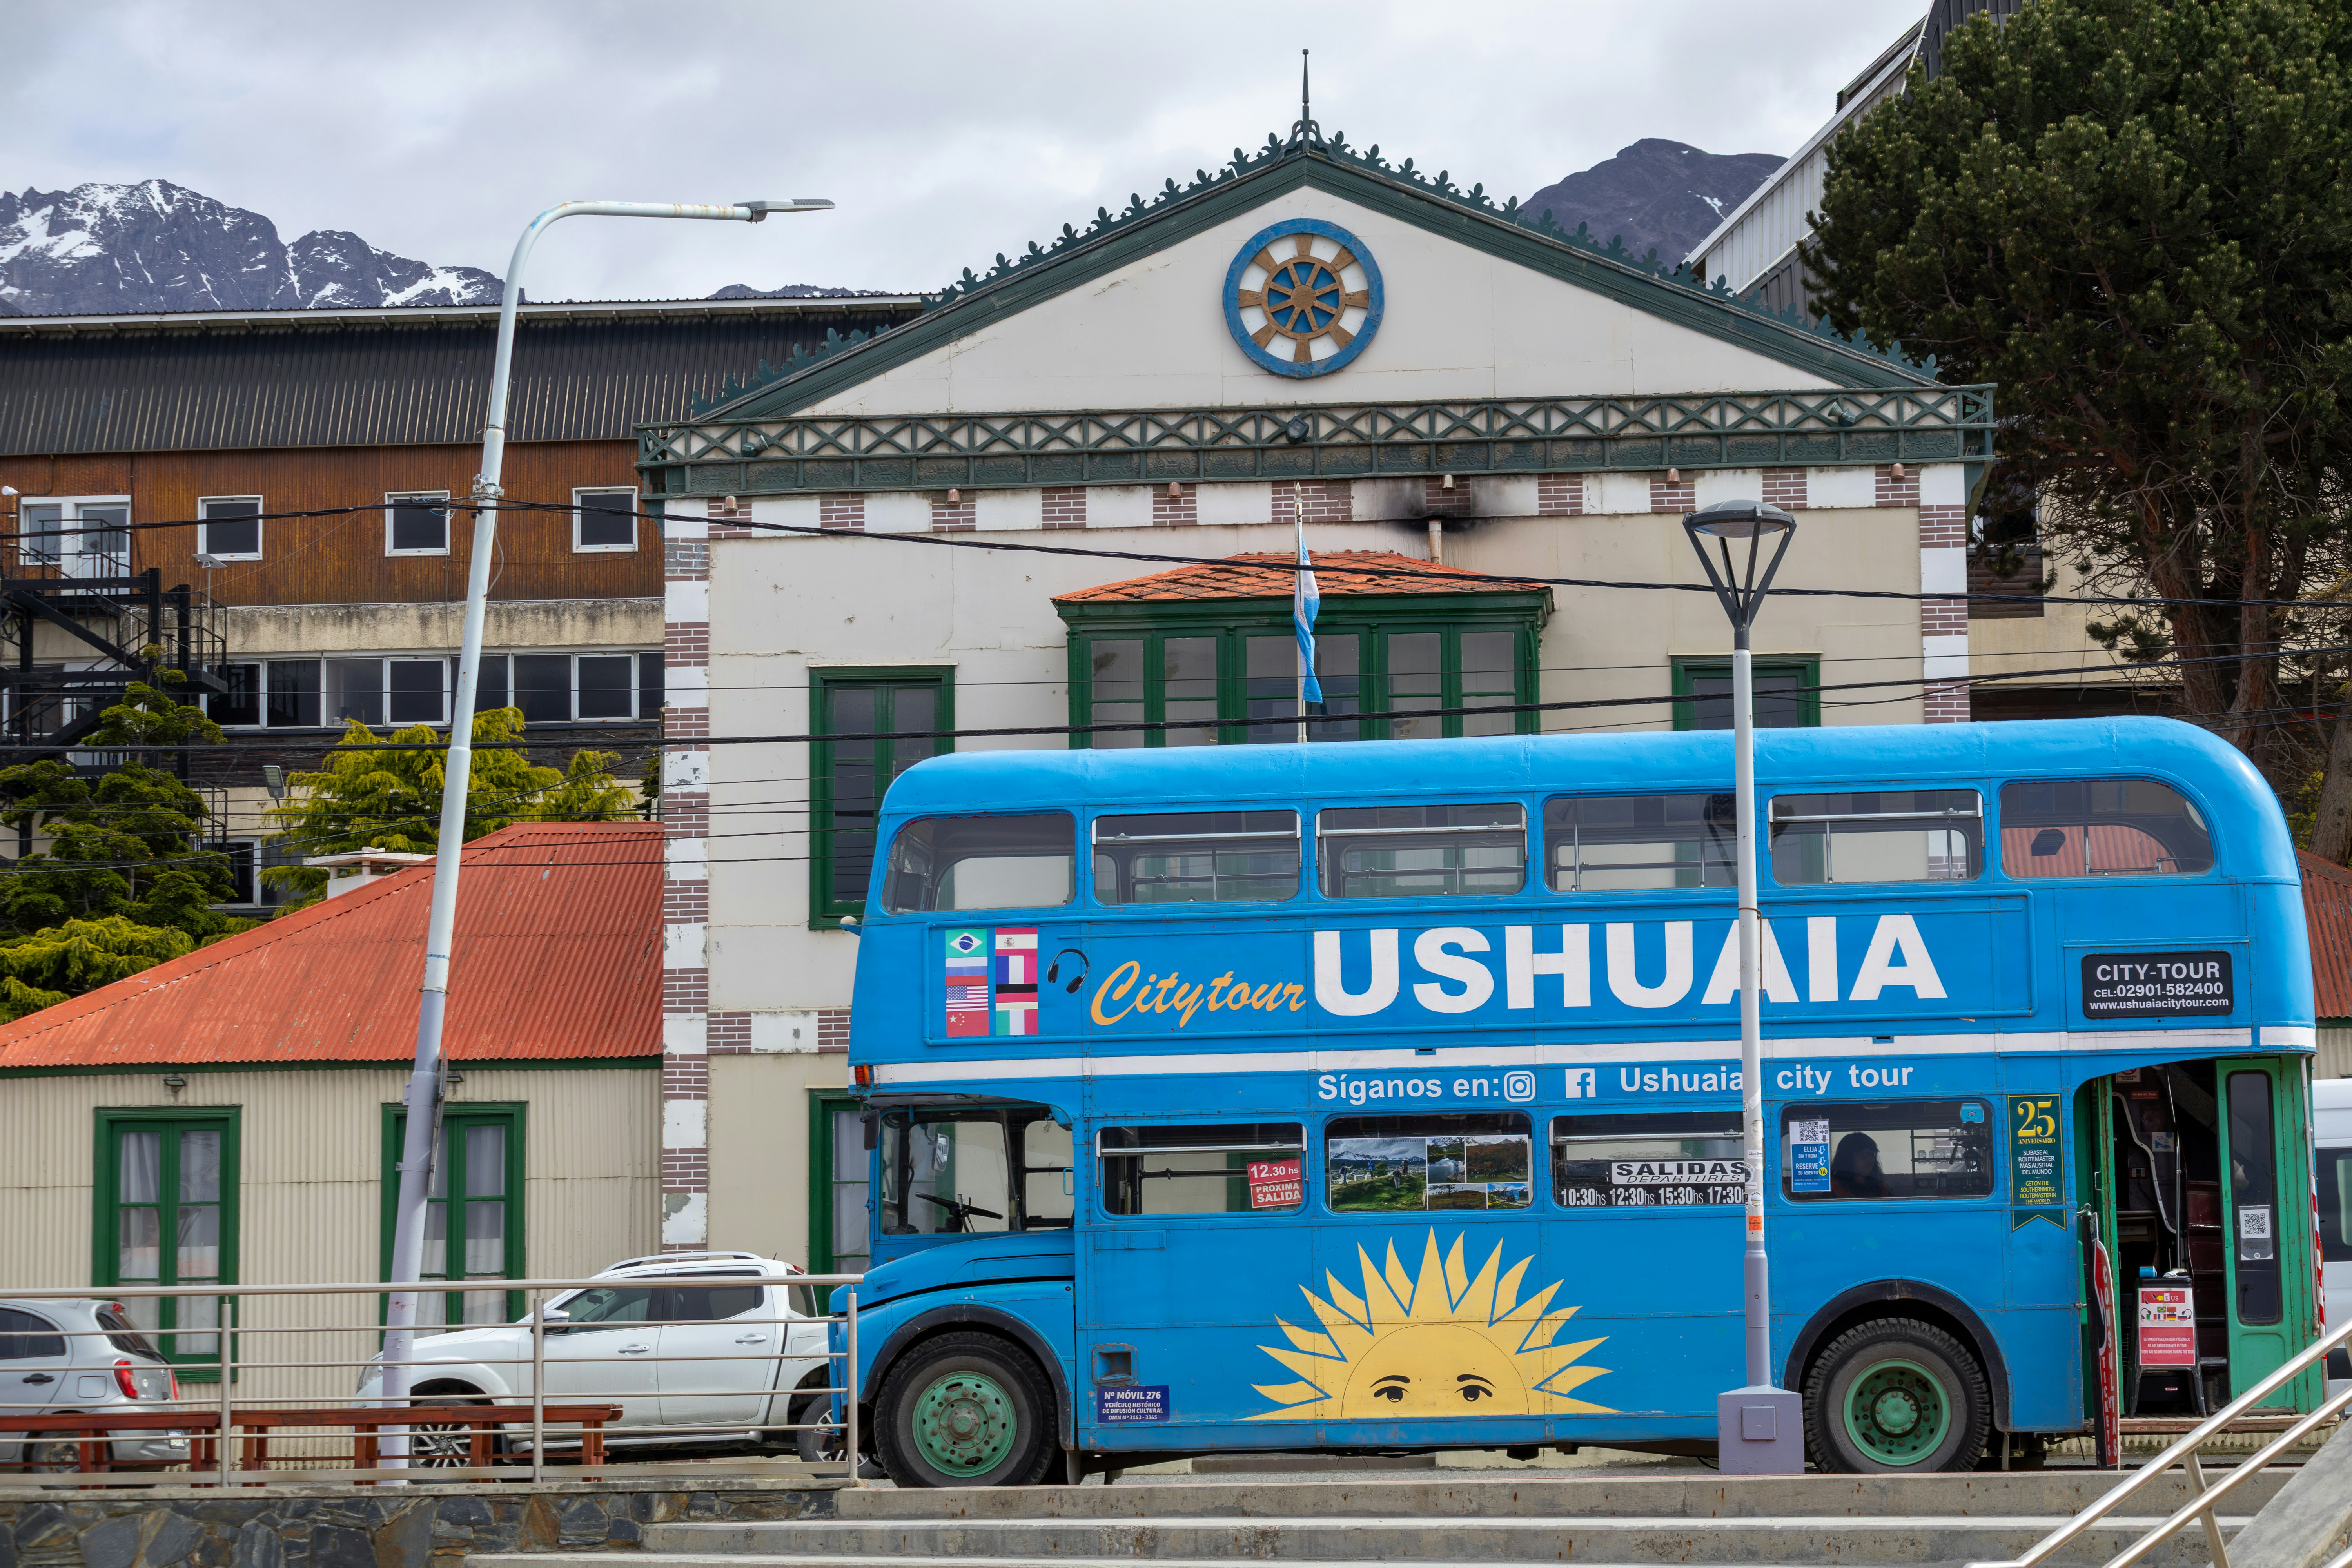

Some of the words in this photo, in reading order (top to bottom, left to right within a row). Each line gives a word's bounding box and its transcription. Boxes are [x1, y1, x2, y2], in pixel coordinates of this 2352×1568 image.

[1314, 915, 1948, 1017] USHUAIA
[2096, 962, 2220, 981] CITY-TOUR
[2089, 998, 2229, 1009] www.ushuaiacitytour.com
[1620, 1066, 1743, 1092] Ushuaia
[1777, 1064, 1832, 1095] city
[1849, 1064, 1914, 1087] tour
[1318, 1074, 1443, 1105] Síganos
[1453, 1078, 1499, 1097] en:
[2017, 1099, 2055, 1137] 25
[1250, 1164, 1286, 1178] 12.30
[1616, 1161, 1745, 1176] SALIDAS
[1627, 1174, 1741, 1183] DEPARTURES
[1256, 1182, 1299, 1193] PROXIMA
[1257, 1190, 1301, 1203] SALIDA
[1561, 1187, 1606, 1206] 10:30hs
[1610, 1187, 1655, 1206] 12:30hs
[1658, 1186, 1703, 1205] 15:30hs
[1707, 1186, 1746, 1204] 17:30h
[1117, 1389, 1145, 1399] MÓVIL
